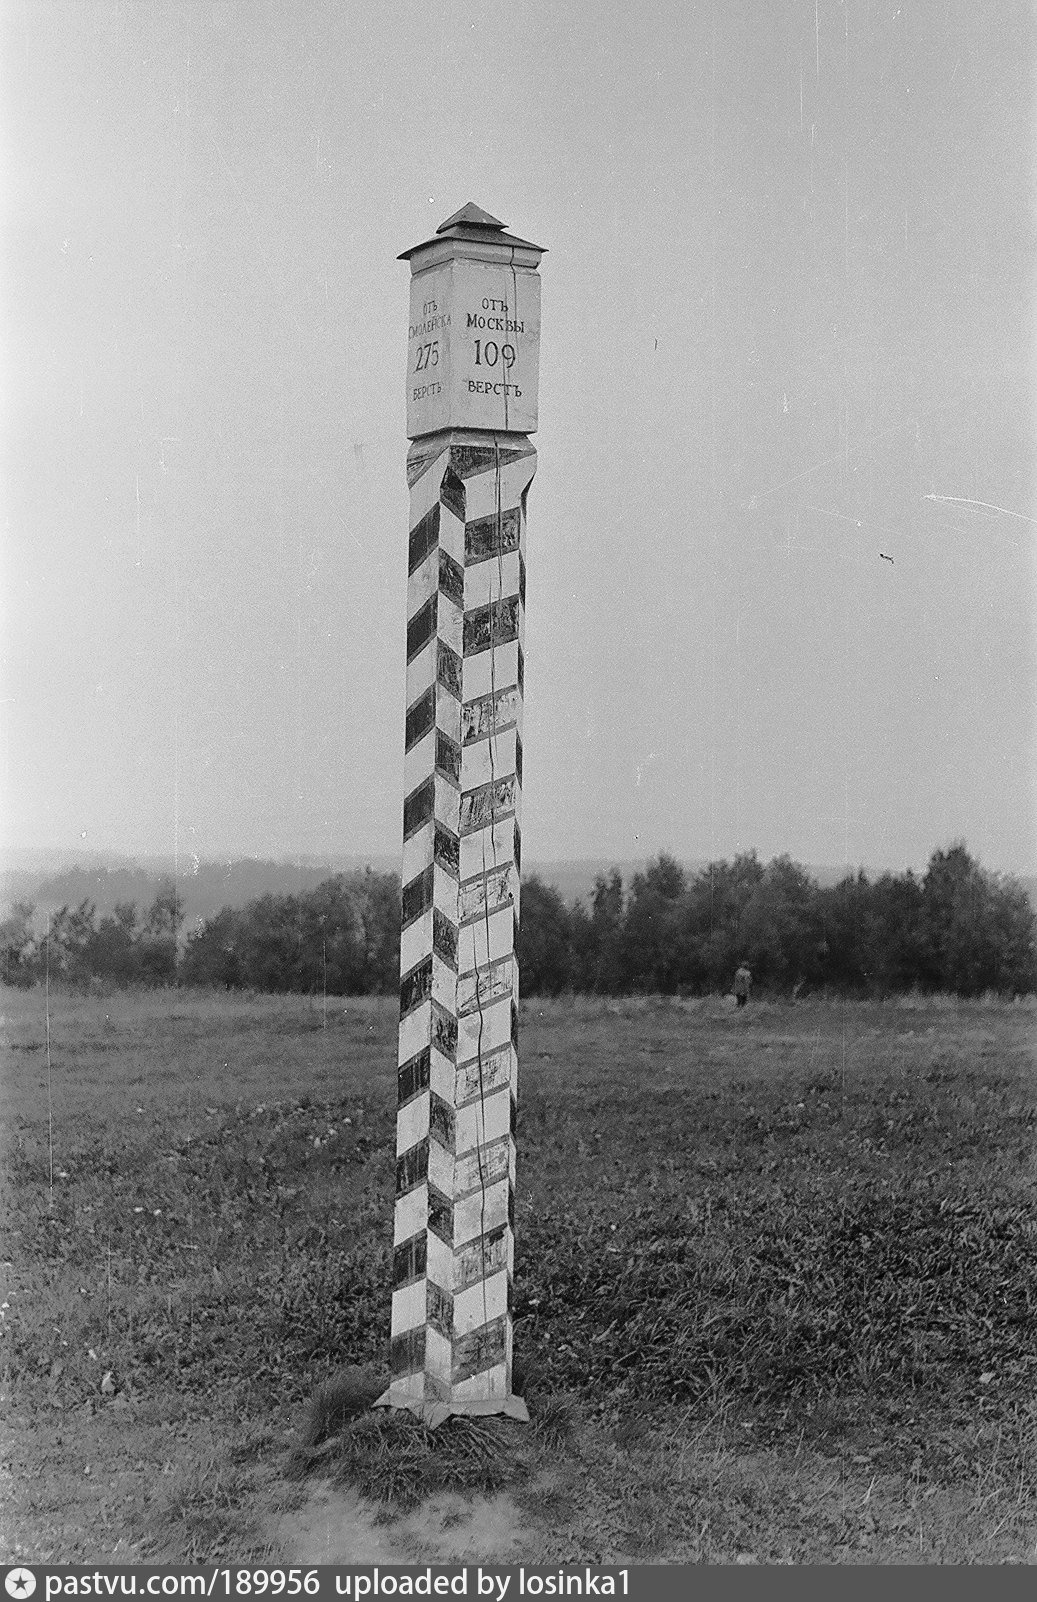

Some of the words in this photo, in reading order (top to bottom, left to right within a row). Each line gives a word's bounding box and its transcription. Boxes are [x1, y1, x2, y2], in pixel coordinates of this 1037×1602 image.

[423, 300, 438, 315] ОТЪ
[482, 297, 509, 312] ОТЪ
[466, 313, 525, 333] МОСКВЫ
[413, 341, 439, 374] 275
[474, 339, 516, 369] 109
[413, 382, 442, 401] ВЕРСТЪ
[467, 380, 522, 397] ВЕРСТЪ
